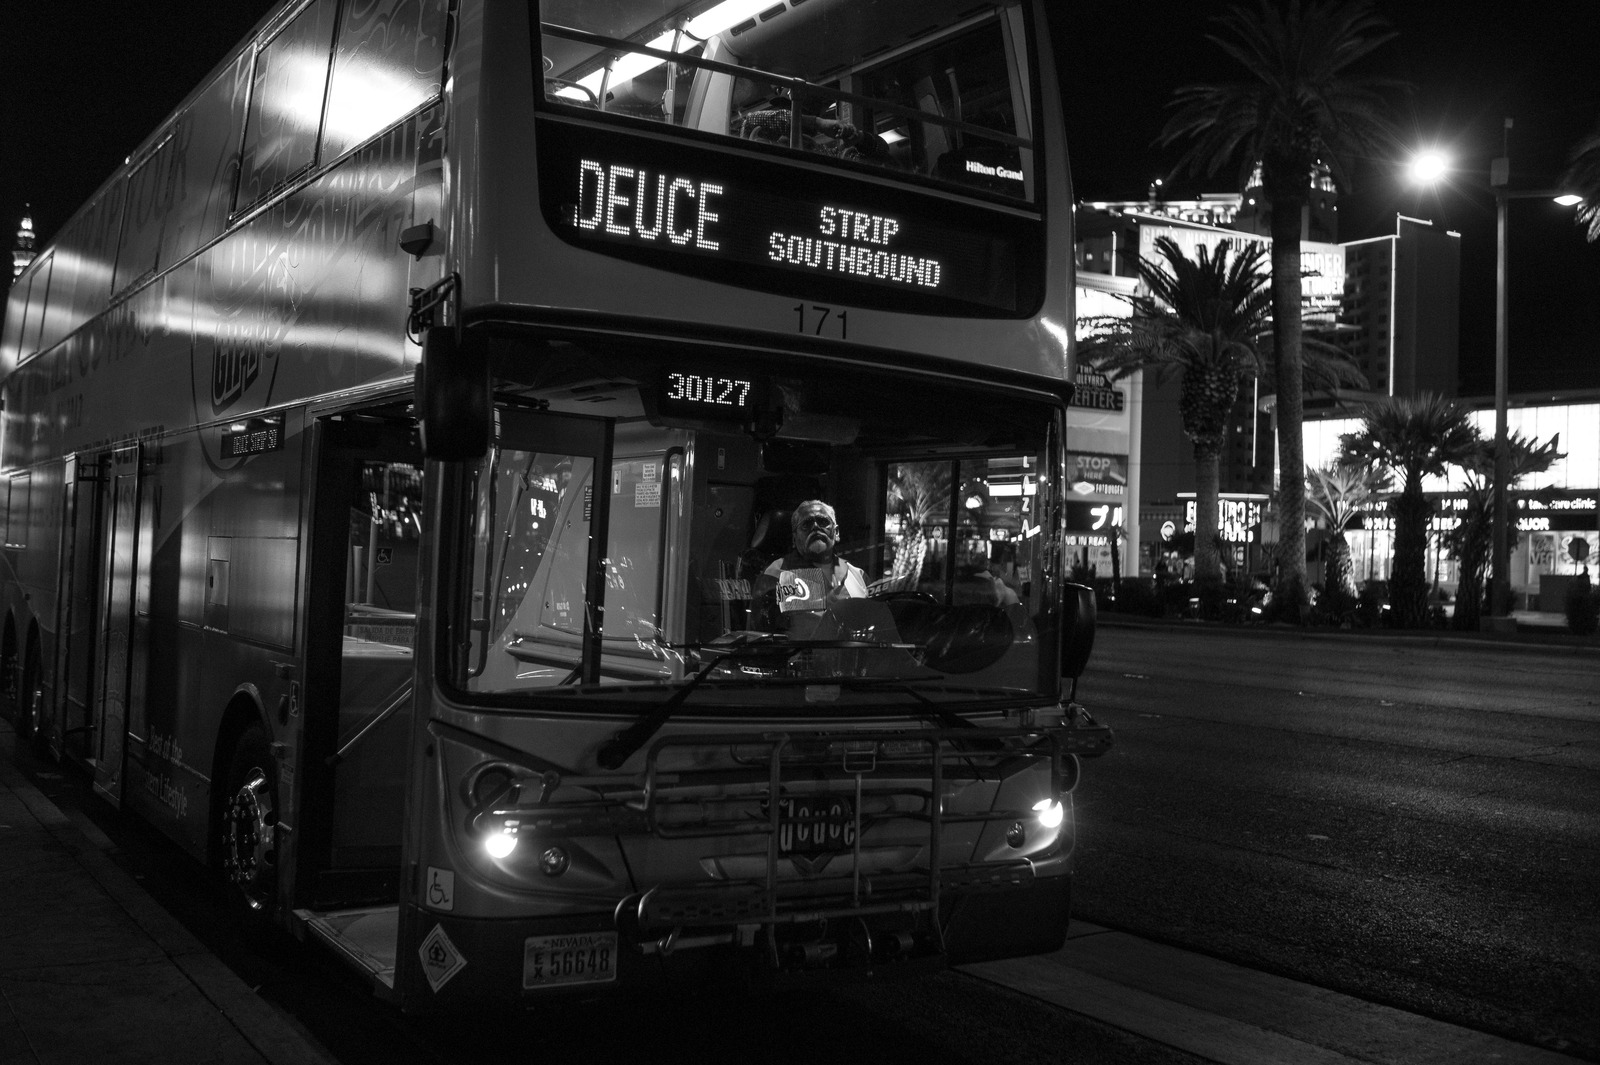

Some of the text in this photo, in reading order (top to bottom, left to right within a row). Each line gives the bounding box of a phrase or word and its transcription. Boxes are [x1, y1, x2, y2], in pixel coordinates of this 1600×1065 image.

[966, 160, 1024, 181] Hilton Grand
[573, 159, 723, 251] DEUCE
[820, 206, 899, 245] STRIP
[768, 232, 941, 287] SOUTHBOUND
[793, 303, 848, 340] 171
[668, 373, 751, 406] 30127
[1071, 389, 1115, 409] EATER
[1077, 456, 1110, 470] STOP
[1571, 498, 1596, 510] clinic
[551, 936, 593, 948] NEVADA
[550, 950, 610, 977] 56648
